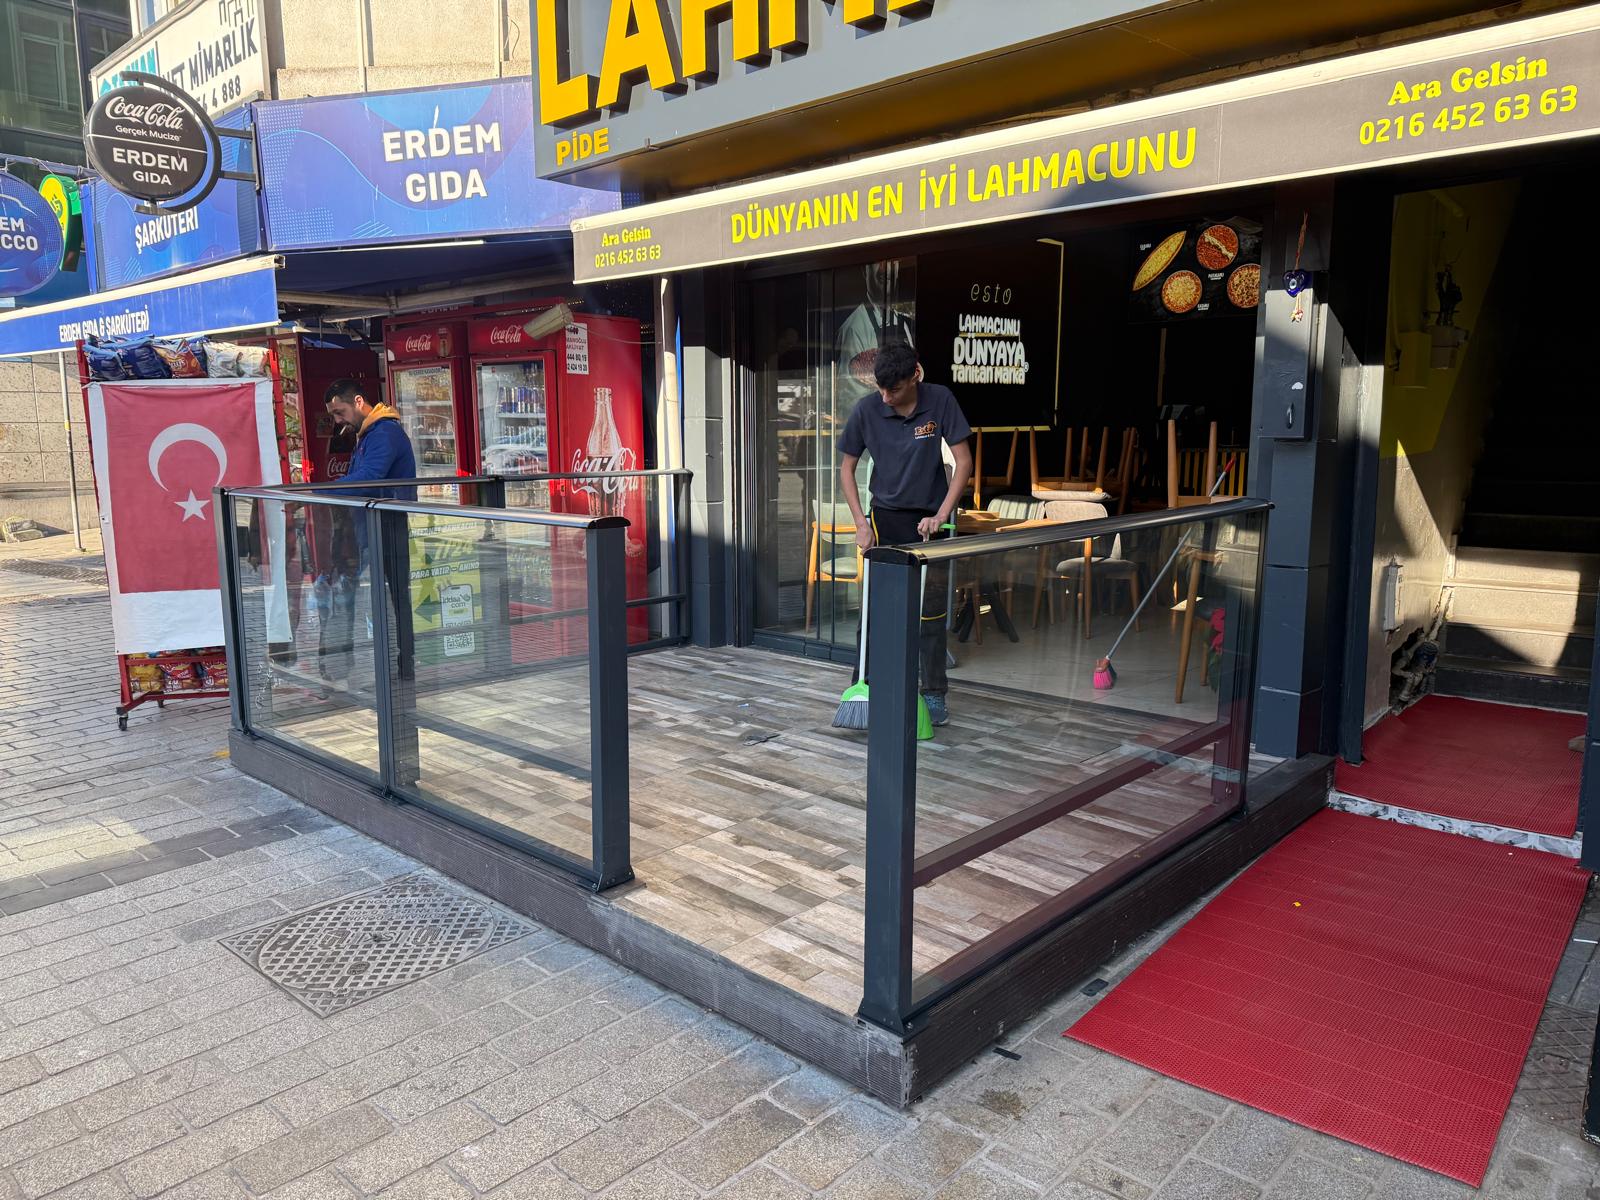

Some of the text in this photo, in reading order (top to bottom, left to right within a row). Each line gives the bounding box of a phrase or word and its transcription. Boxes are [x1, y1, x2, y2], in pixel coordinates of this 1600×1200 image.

[188, 17, 258, 91] MİMARLIK
[222, 74, 241, 103] 888
[1387, 56, 1548, 106] Ara Gelsin
[105, 96, 185, 130] Coca-Cola
[1359, 84, 1578, 145] 0216 452 63 63
[115, 125, 180, 142] Gerçek Mucize
[383, 121, 502, 163] ERDEM
[556, 127, 609, 166] PİDE
[112, 147, 188, 172] ERDEM
[132, 170, 172, 186] GIDA
[405, 168, 489, 203] GIDA
[731, 126, 1197, 244] DÜNYANIN EN İYİ LAHMACUNU
[0, 234, 39, 251] CCO
[601, 226, 652, 247] Ara Gelsin
[595, 244, 661, 268] 0216 452 63 63
[970, 283, 1012, 305] esto
[59, 321, 82, 342] ERDEM
[82, 318, 101, 339] GIDA
[958, 313, 1021, 337] LAHMACUNU
[953, 332, 1025, 367] DÜNYAYA
[410, 568, 431, 580] PARA
